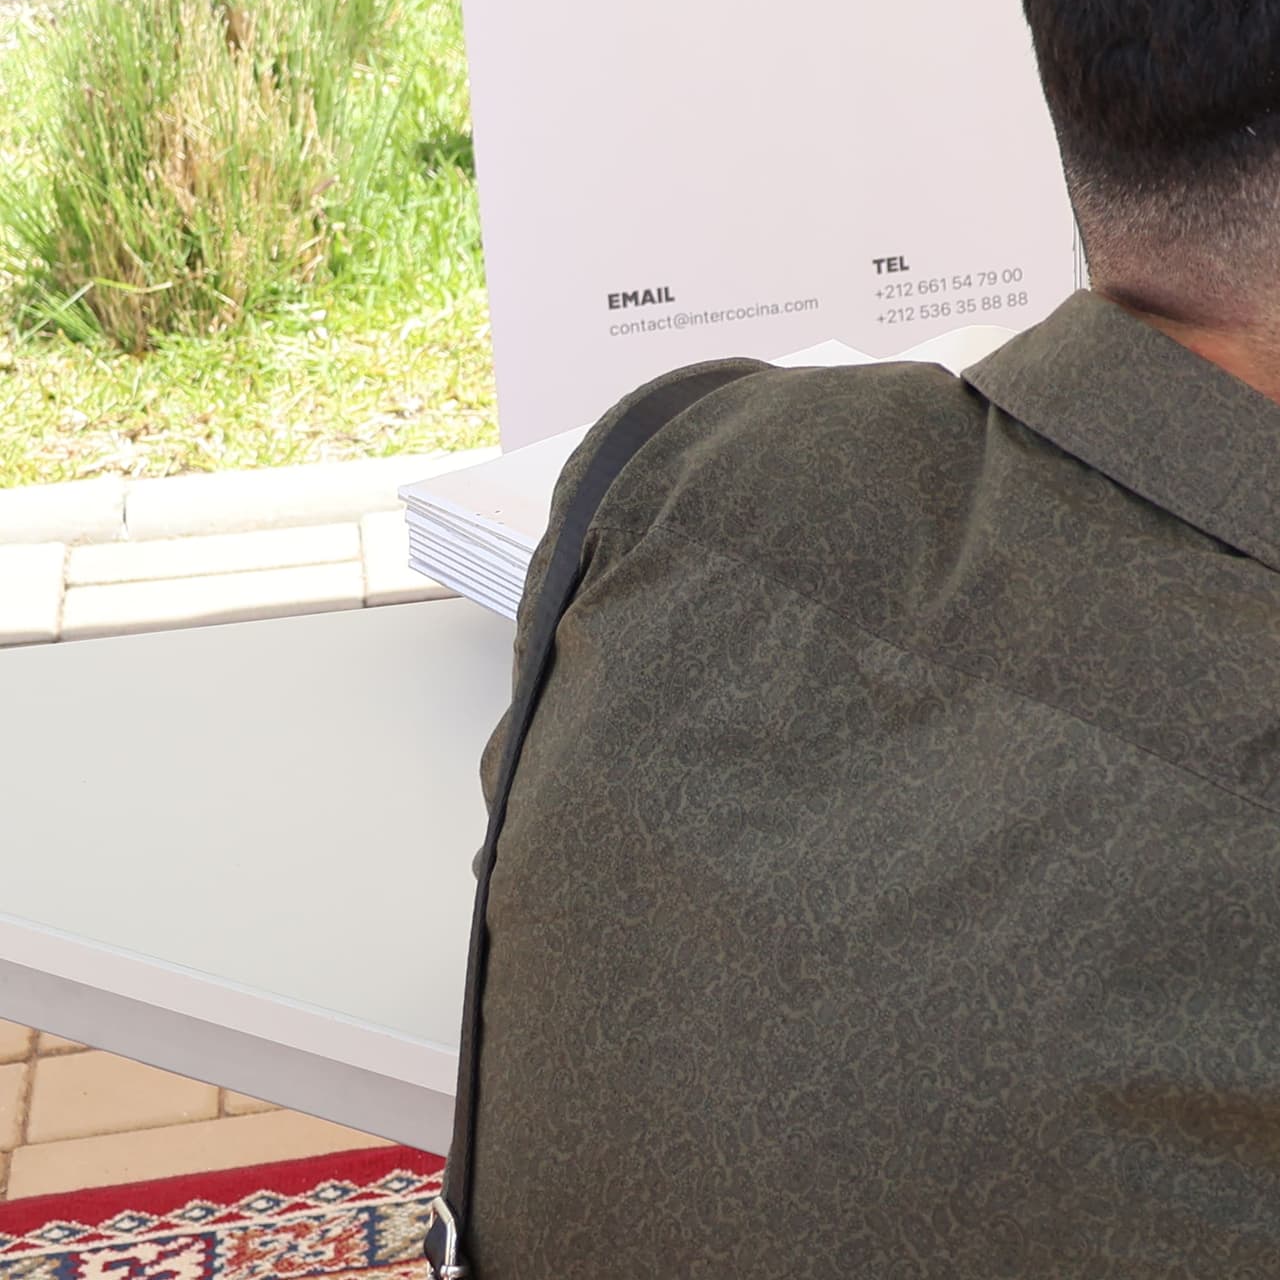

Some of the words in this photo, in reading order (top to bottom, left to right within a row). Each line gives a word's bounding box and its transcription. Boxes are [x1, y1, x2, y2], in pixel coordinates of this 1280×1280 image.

[872, 256, 909, 275] TEL
[607, 286, 676, 310] EMAIL
[875, 282, 913, 301] +212
[918, 278, 947, 297] 661
[951, 274, 973, 293] 54
[977, 271, 998, 289] 79
[1001, 268, 1023, 286] 00
[609, 296, 819, 337] contact@intercocina.com
[877, 306, 916, 325] +212
[919, 302, 952, 321] 536
[955, 298, 977, 316] 35
[981, 294, 1003, 312] 88
[1006, 291, 1029, 309] 88
